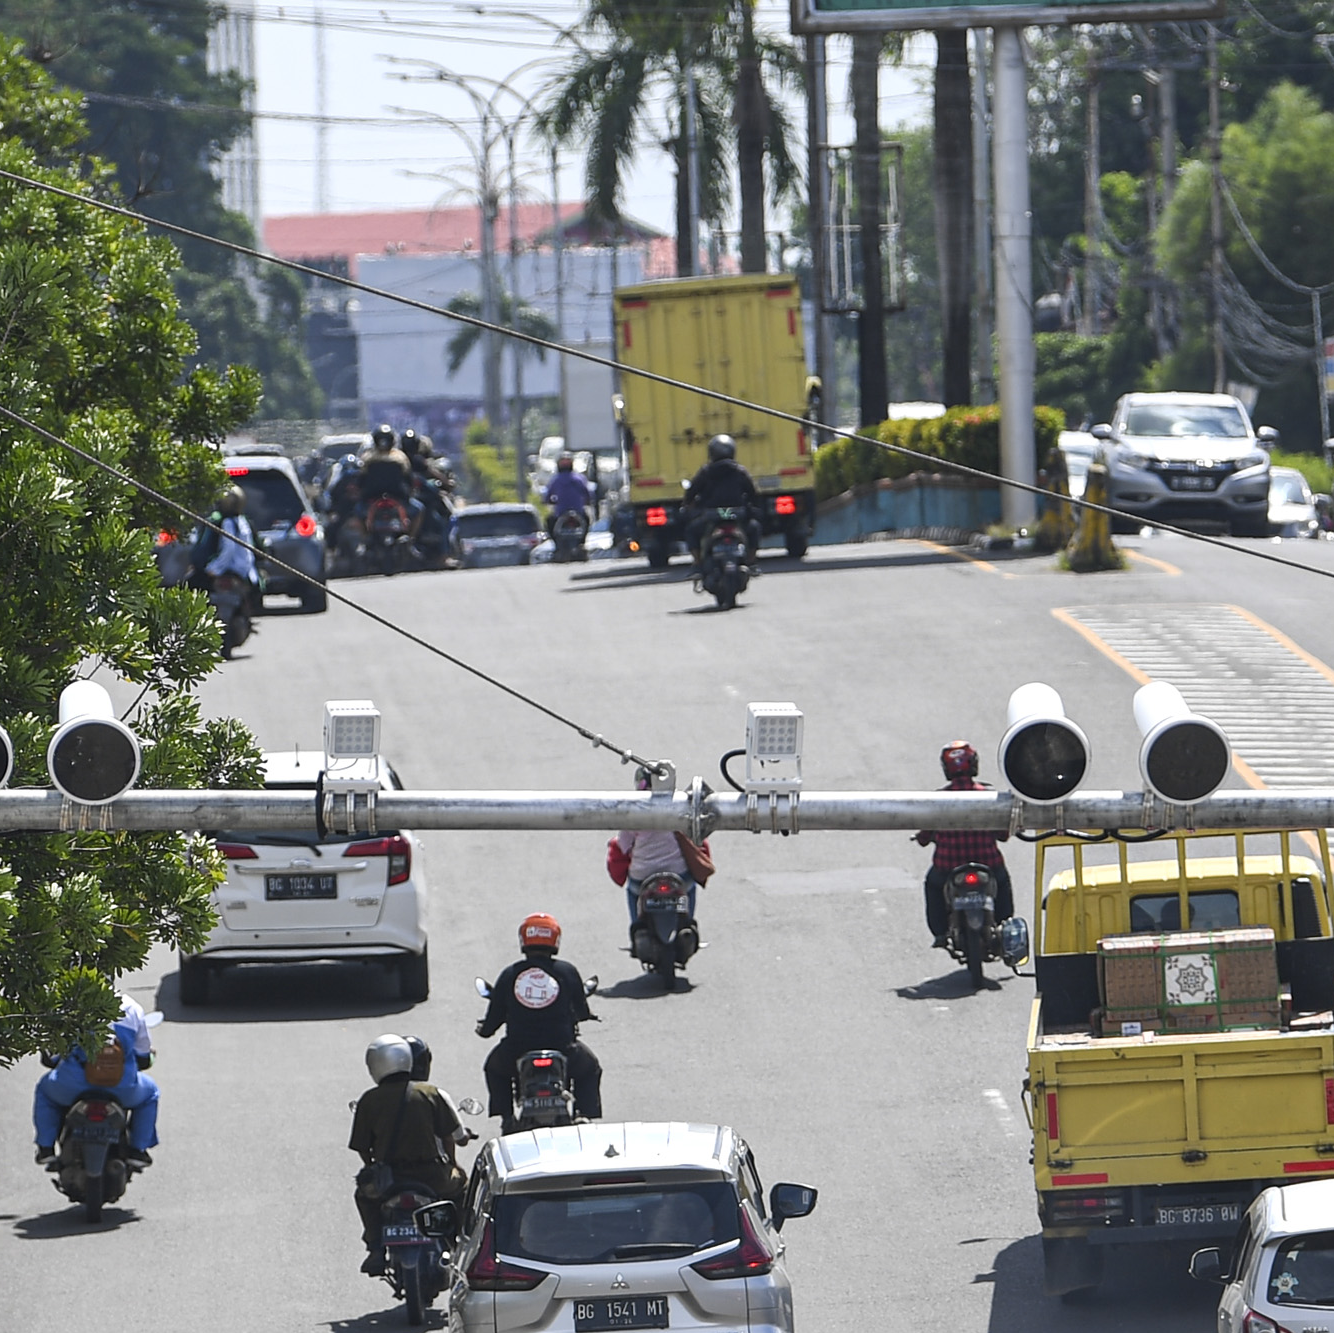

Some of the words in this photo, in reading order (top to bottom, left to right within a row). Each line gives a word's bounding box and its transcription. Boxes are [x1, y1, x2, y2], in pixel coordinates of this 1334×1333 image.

[1160, 1209, 1175, 1224] BG
[1183, 1207, 1214, 1223] 8736
[577, 1304, 594, 1320] BG
[607, 1302, 637, 1318] 1541
[647, 1300, 664, 1316] MT
